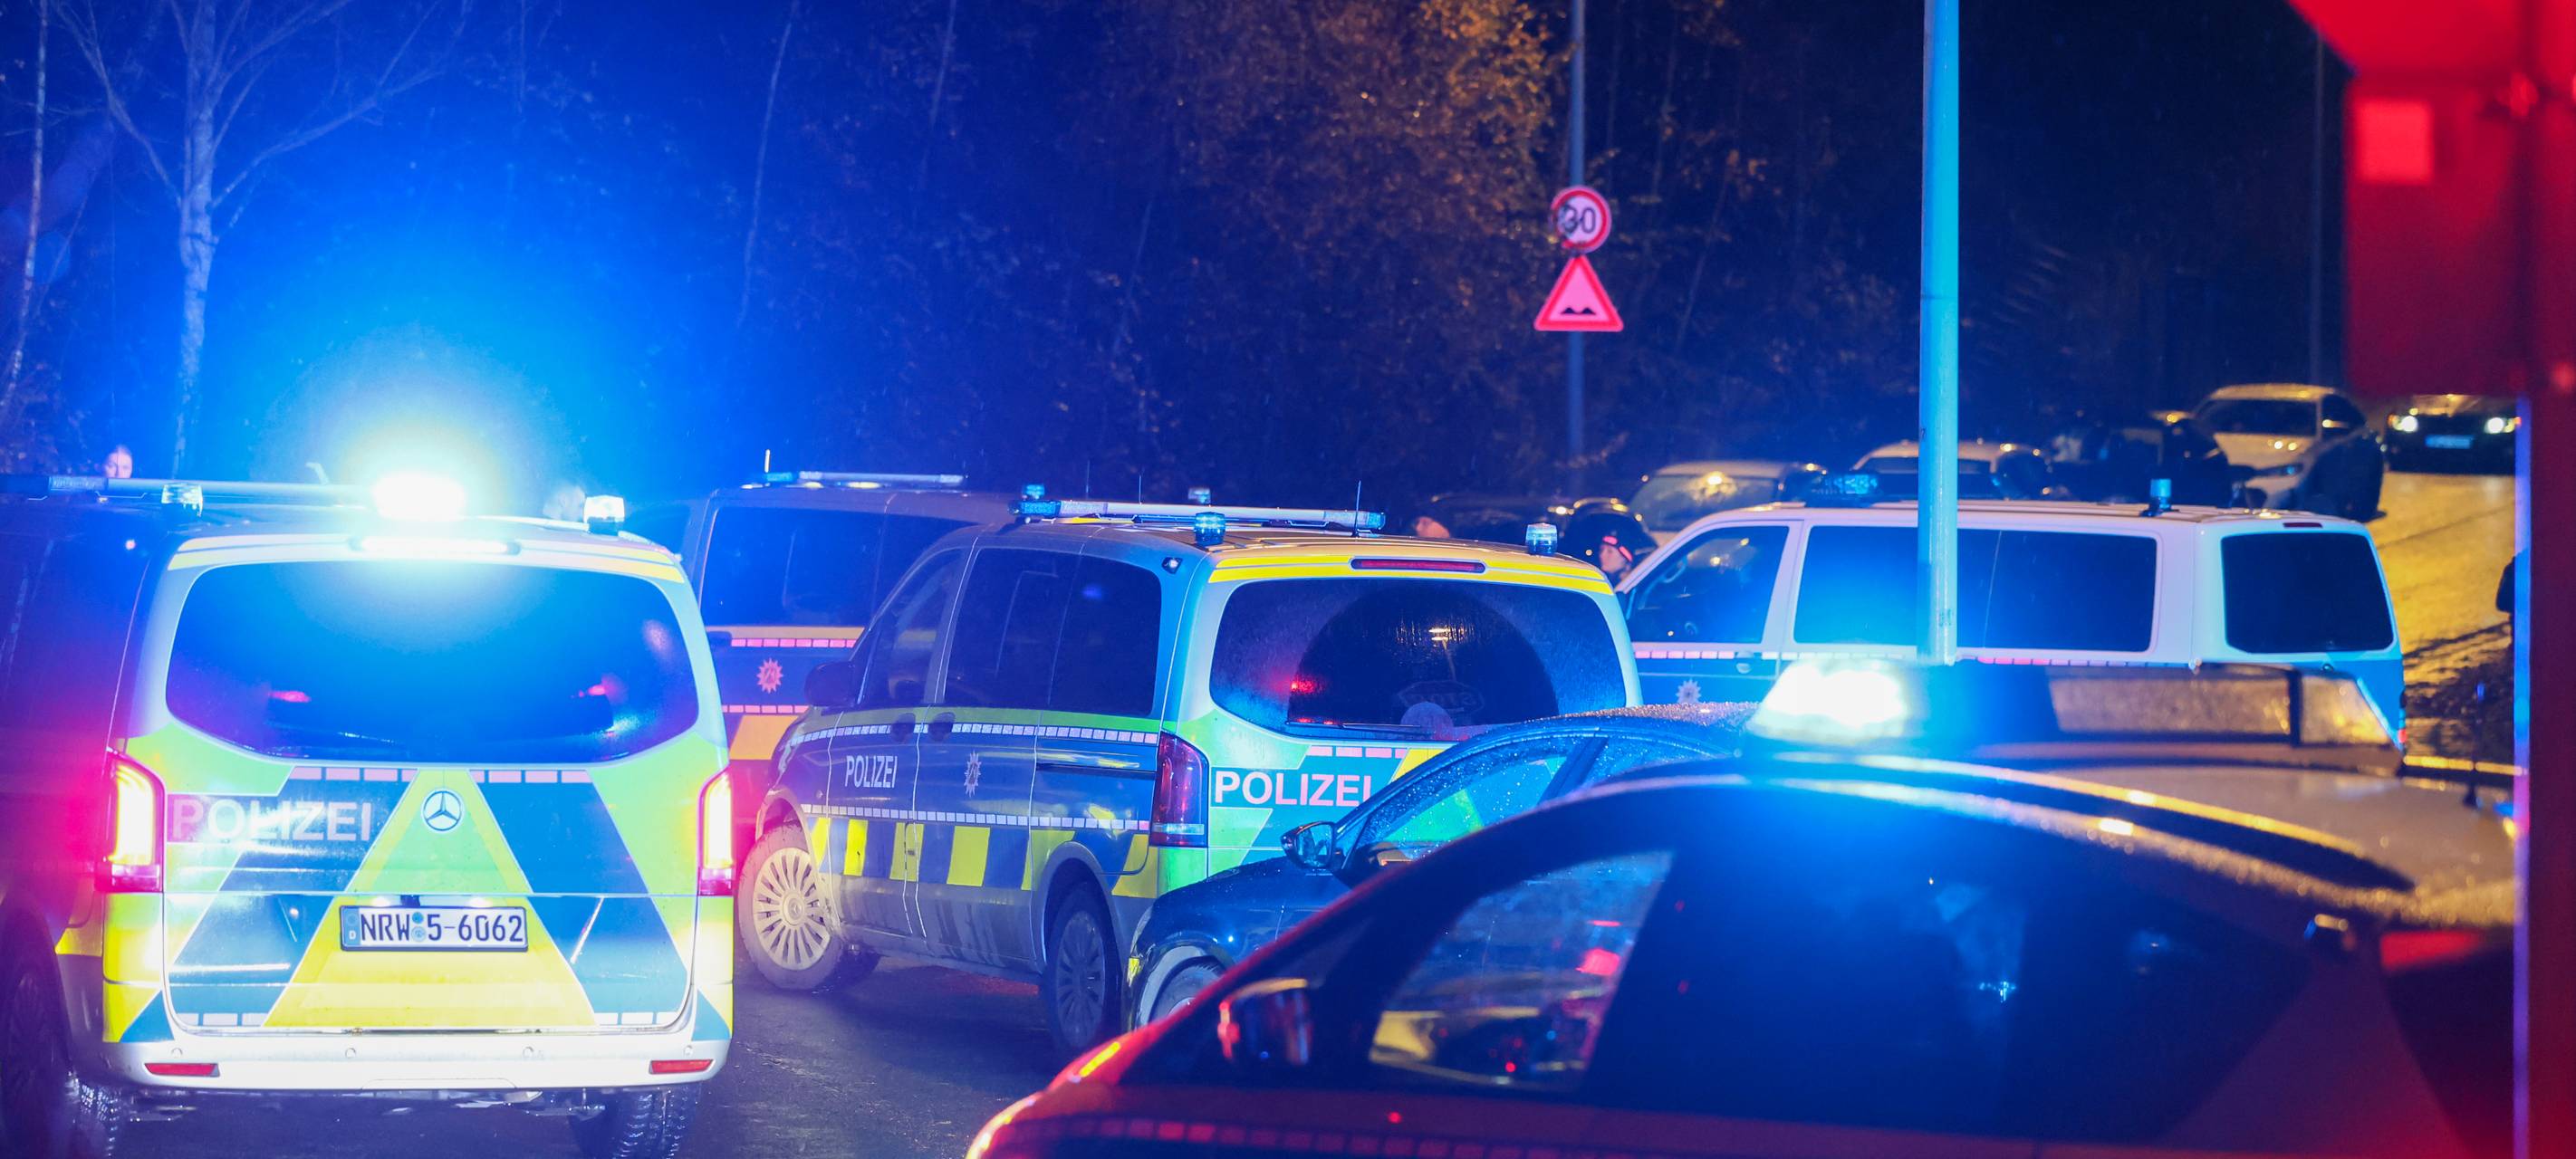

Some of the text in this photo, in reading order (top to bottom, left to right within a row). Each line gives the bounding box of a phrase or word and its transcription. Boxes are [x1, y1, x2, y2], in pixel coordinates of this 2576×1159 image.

[1562, 206, 1596, 234] 30
[845, 755, 898, 788] POLIZEI
[1215, 771, 1371, 807] POLIZEI
[172, 799, 372, 841] POLIZEI
[360, 914, 524, 943] NRW 5-6062
